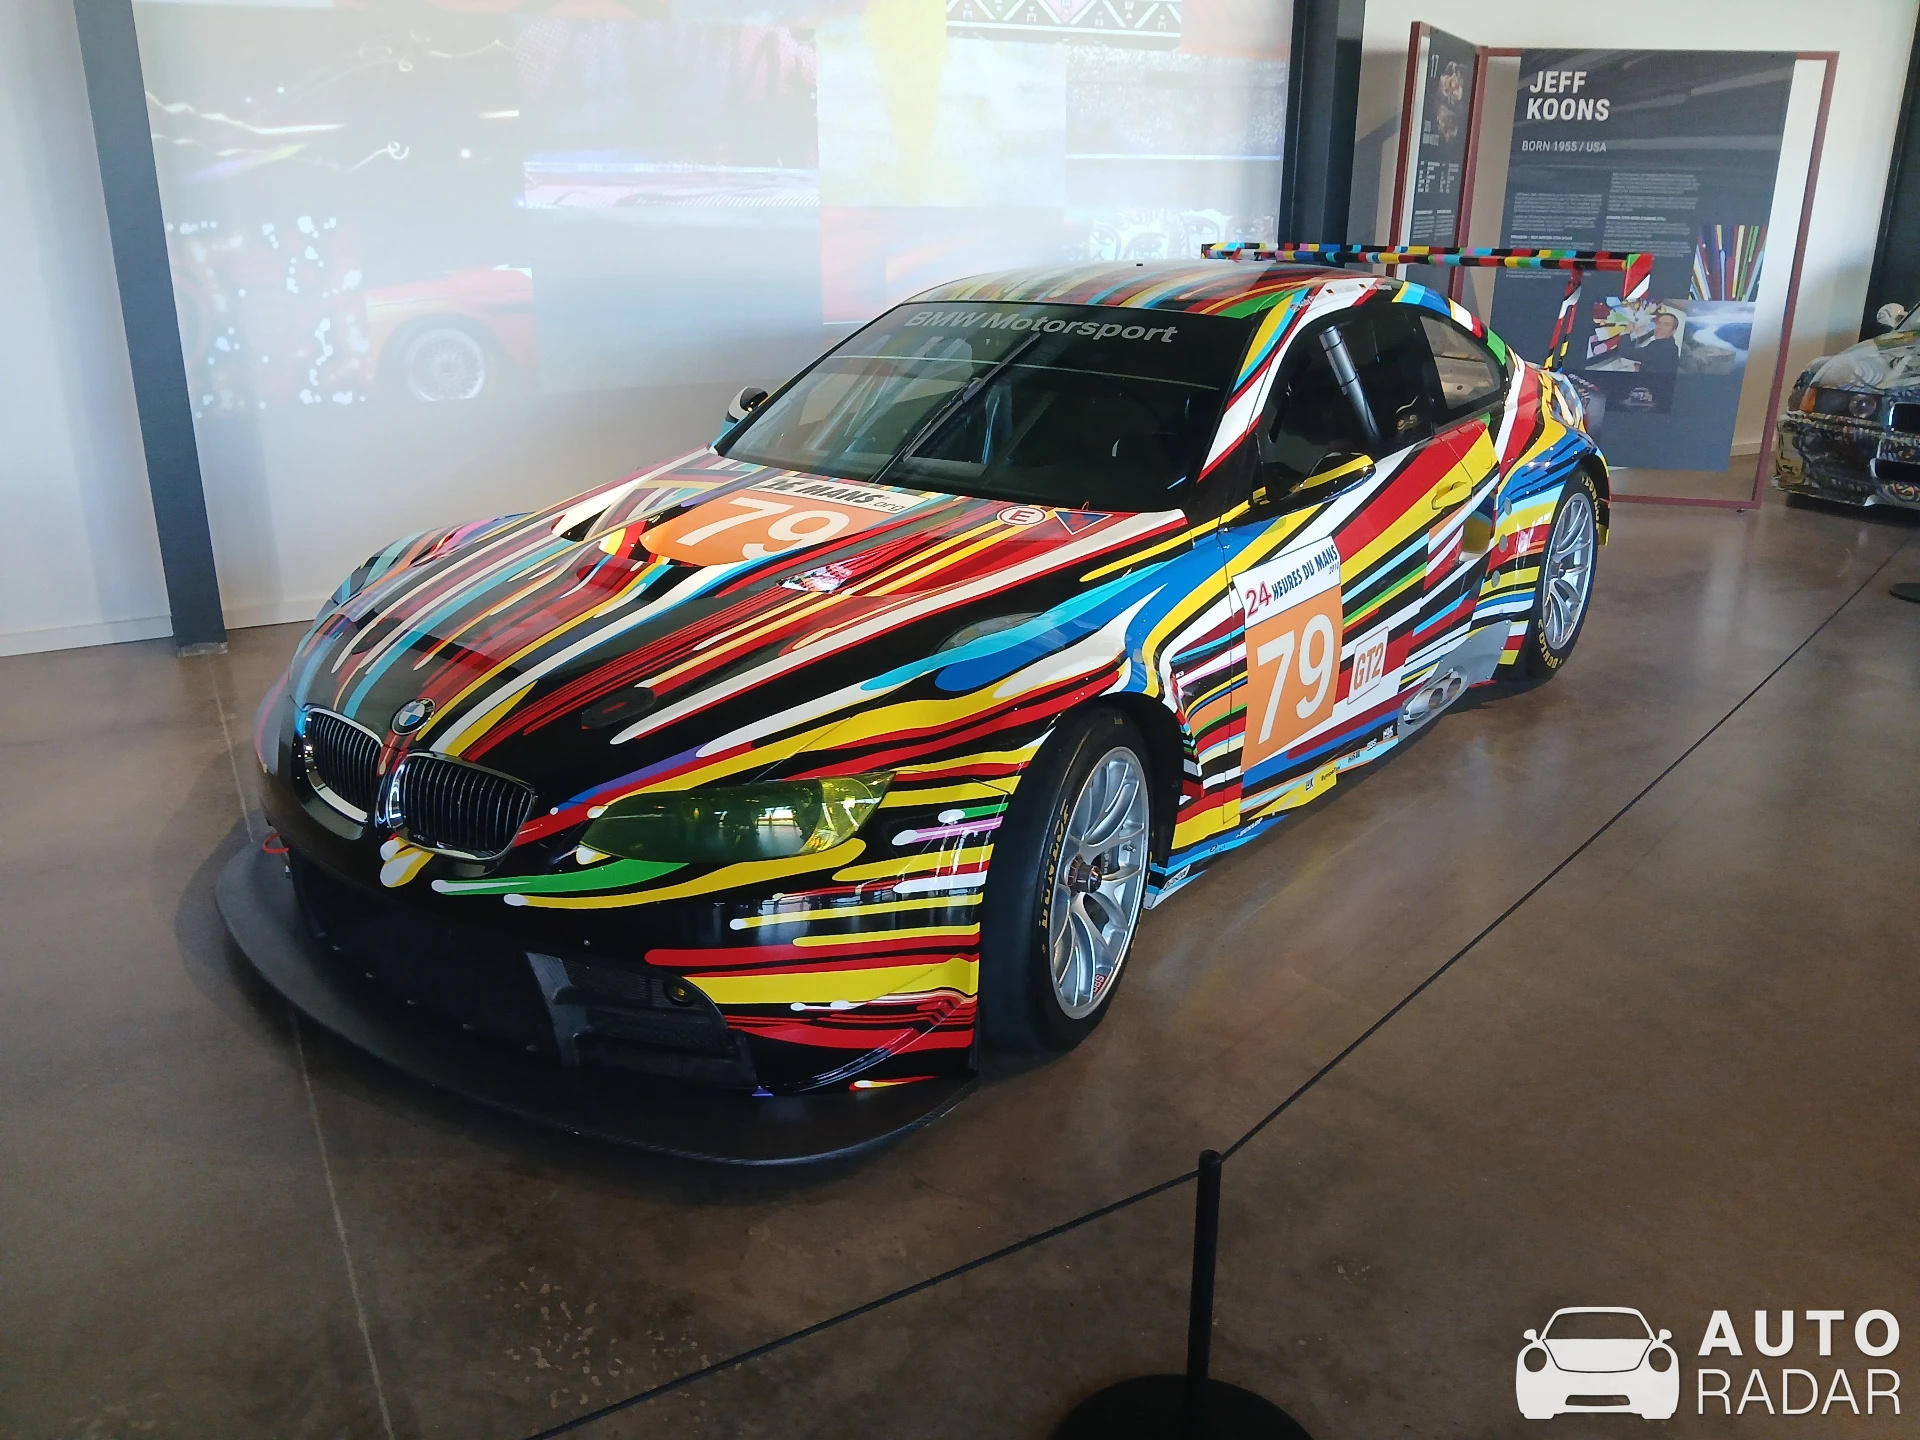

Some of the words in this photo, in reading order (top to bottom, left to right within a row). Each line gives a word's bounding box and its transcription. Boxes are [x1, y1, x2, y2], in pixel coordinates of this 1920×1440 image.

[1529, 70, 1587, 94] JEFF
[1526, 97, 1610, 121] KOONS
[1522, 140, 1551, 152] BORN
[1553, 140, 1577, 152] 1955
[1586, 141, 1607, 153] USA
[904, 311, 987, 328] BMW
[980, 312, 1178, 343] Motorsport
[675, 496, 850, 560] 79
[1246, 581, 1272, 618] 24
[1271, 568, 1303, 601] HEURES
[1302, 560, 1315, 580] DU
[1314, 545, 1338, 572] MANS
[1257, 613, 1334, 745] 79
[1353, 642, 1384, 690] GT2
